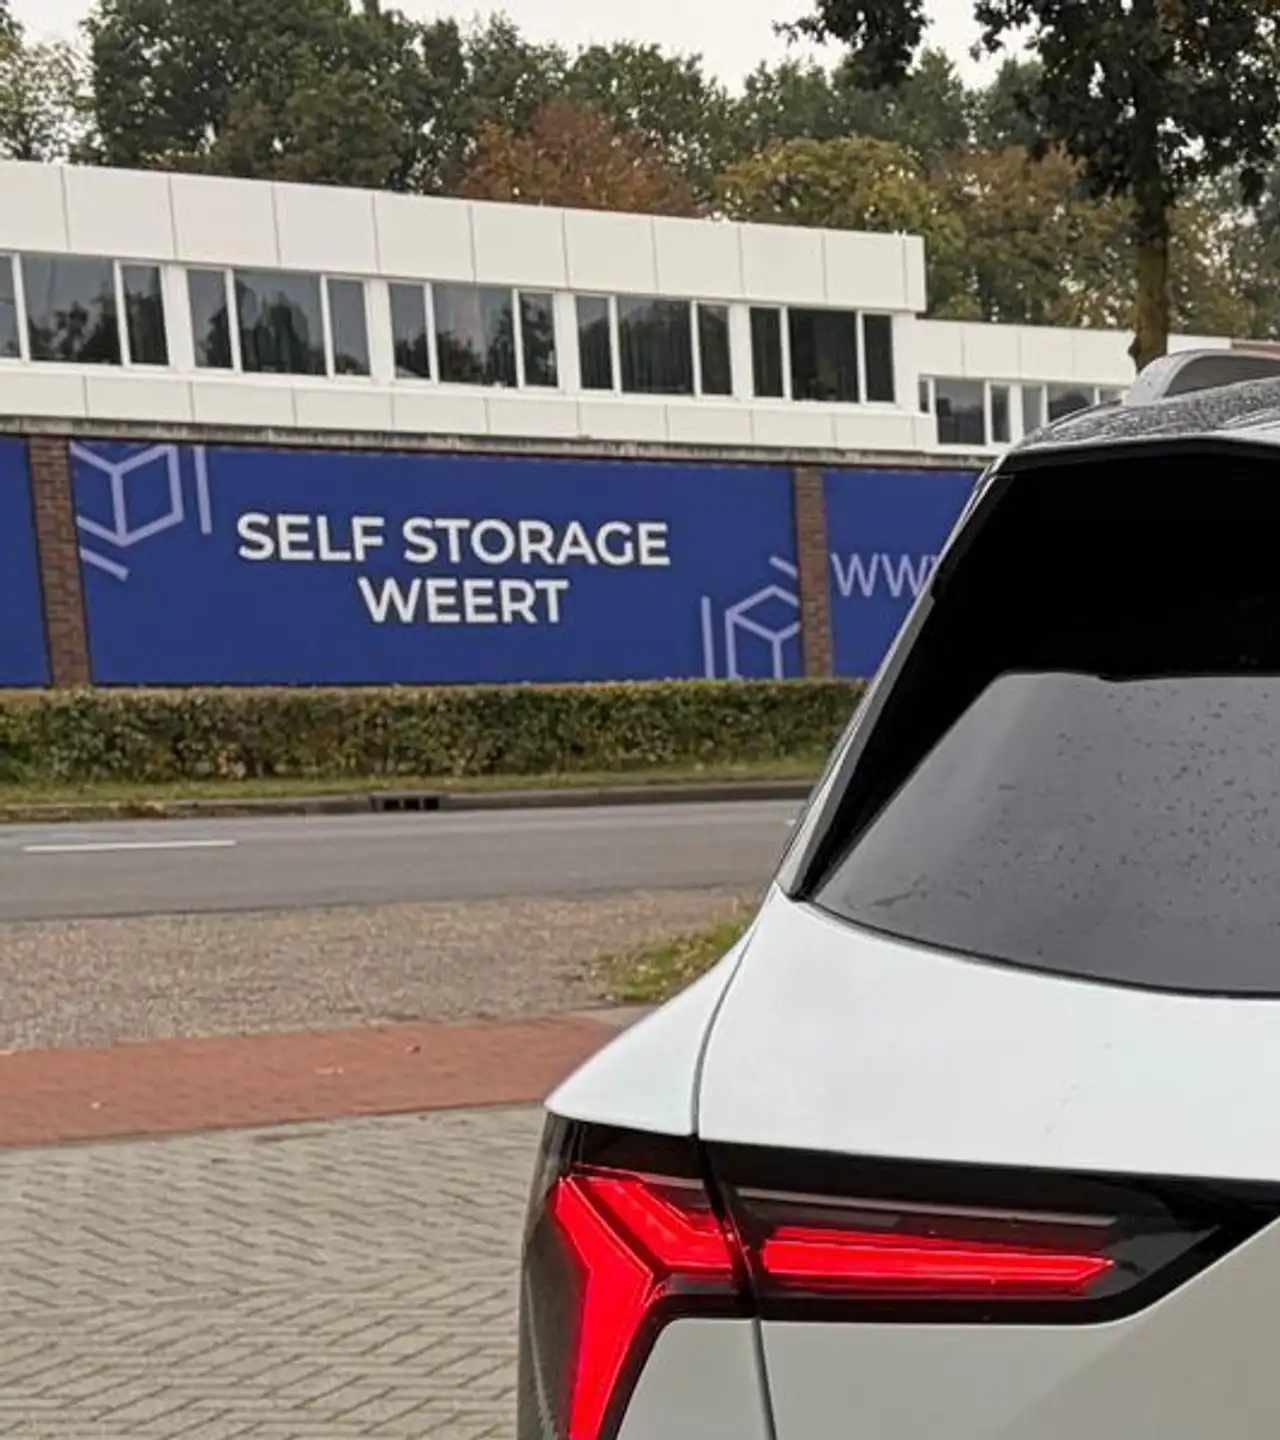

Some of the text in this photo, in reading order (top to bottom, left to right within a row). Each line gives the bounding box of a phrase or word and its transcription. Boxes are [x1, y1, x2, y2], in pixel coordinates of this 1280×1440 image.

[236, 512, 672, 567] SELF STORAGE
[830, 553, 938, 598] WW
[357, 576, 570, 625] WEERT
